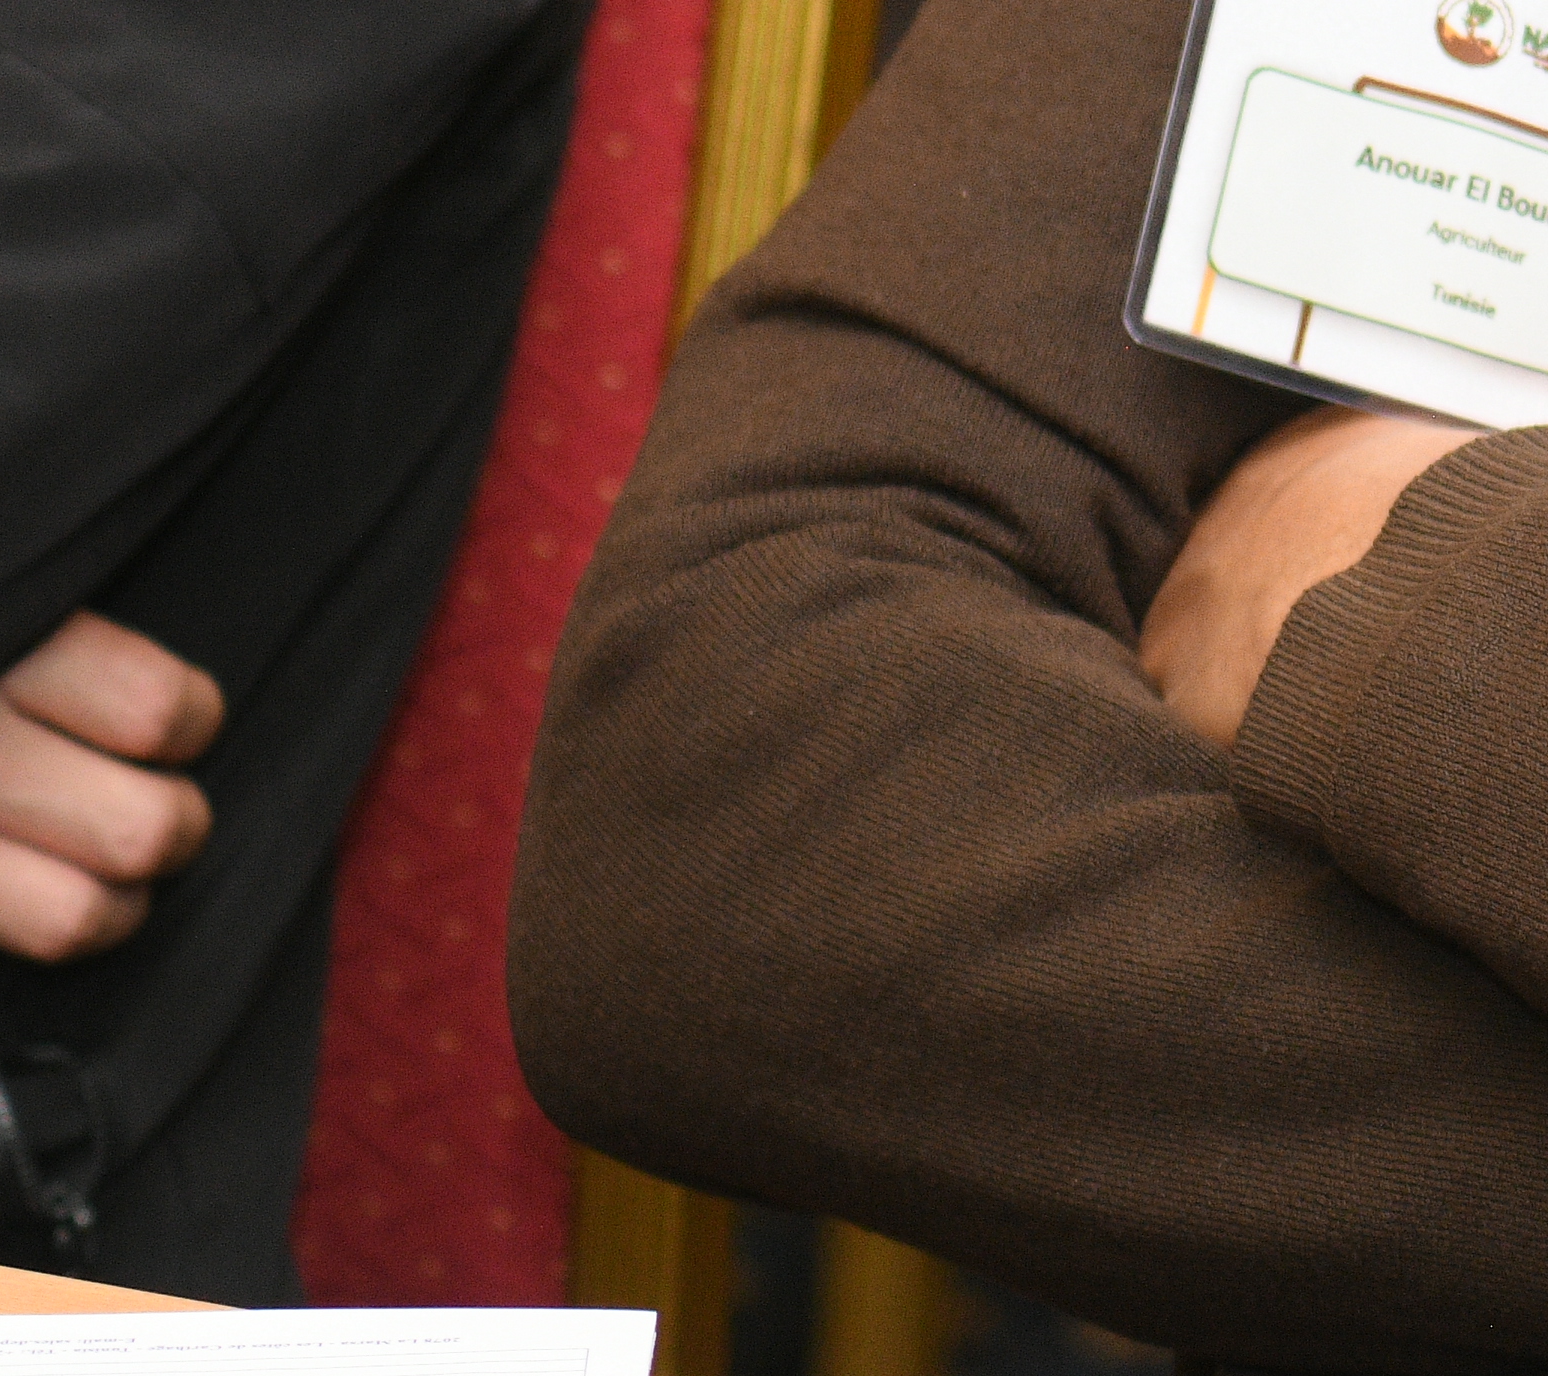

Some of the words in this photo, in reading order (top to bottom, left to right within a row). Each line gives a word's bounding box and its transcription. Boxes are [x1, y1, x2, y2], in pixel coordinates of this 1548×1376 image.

[1355, 145, 1458, 192] Anouar
[1465, 174, 1491, 204] El
[1426, 220, 1526, 265] Agriculteur
[1431, 282, 1497, 319] Tunisie
